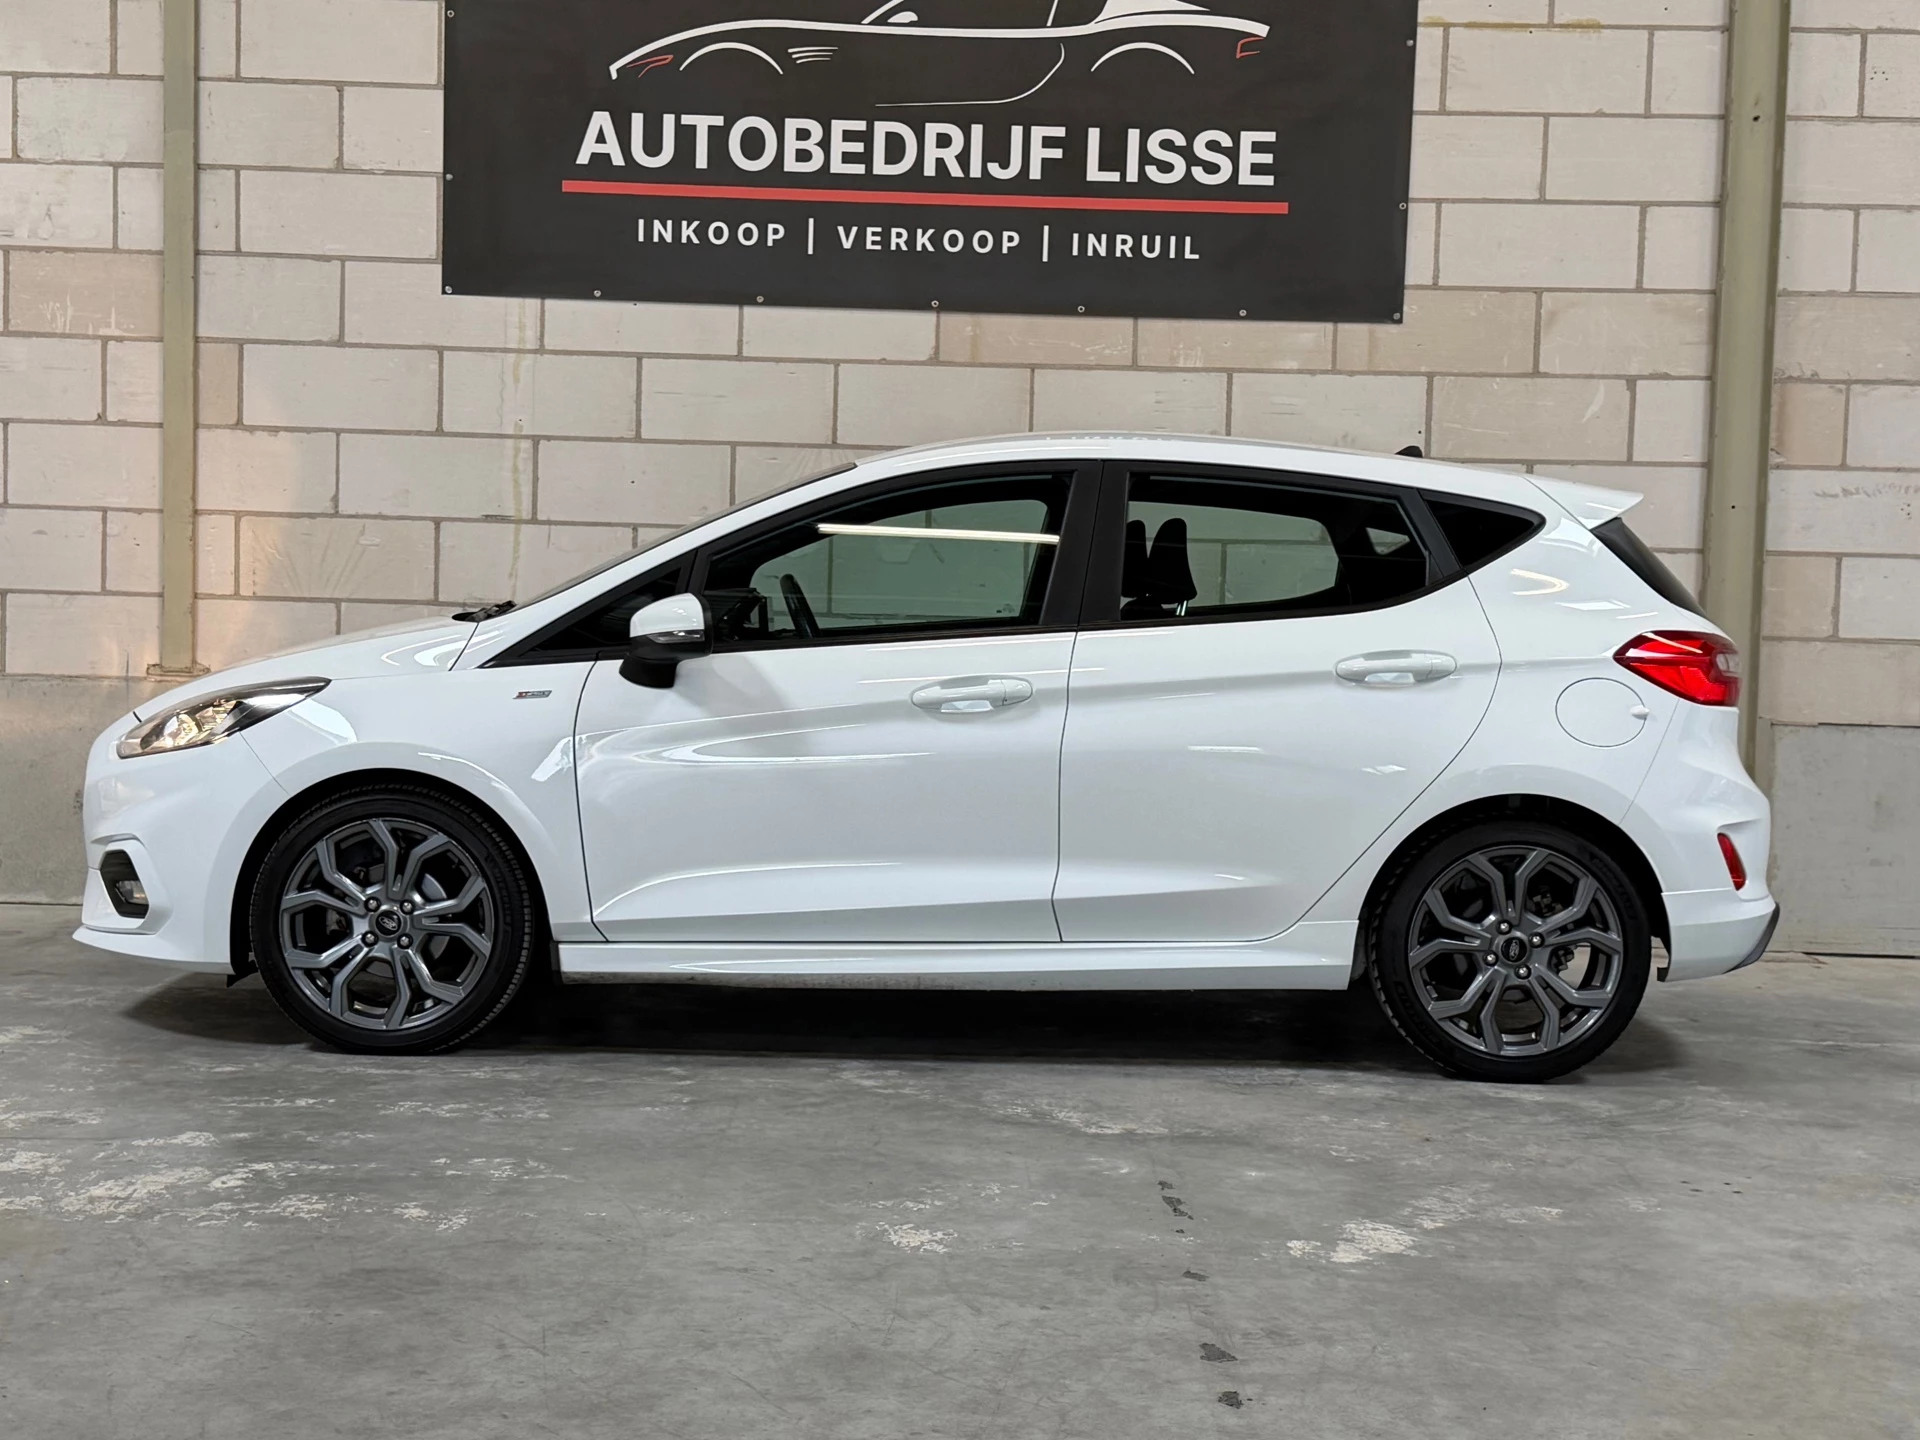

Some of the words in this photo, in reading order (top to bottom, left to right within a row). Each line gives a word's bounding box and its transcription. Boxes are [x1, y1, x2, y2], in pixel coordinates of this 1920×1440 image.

[575, 111, 1066, 180] AUTOBEDRIJF
[1087, 128, 1277, 186] LISSE
[638, 219, 785, 247] INKOOP
[837, 226, 1020, 254] VERKOOP
[1072, 233, 1200, 260] INRUIL
